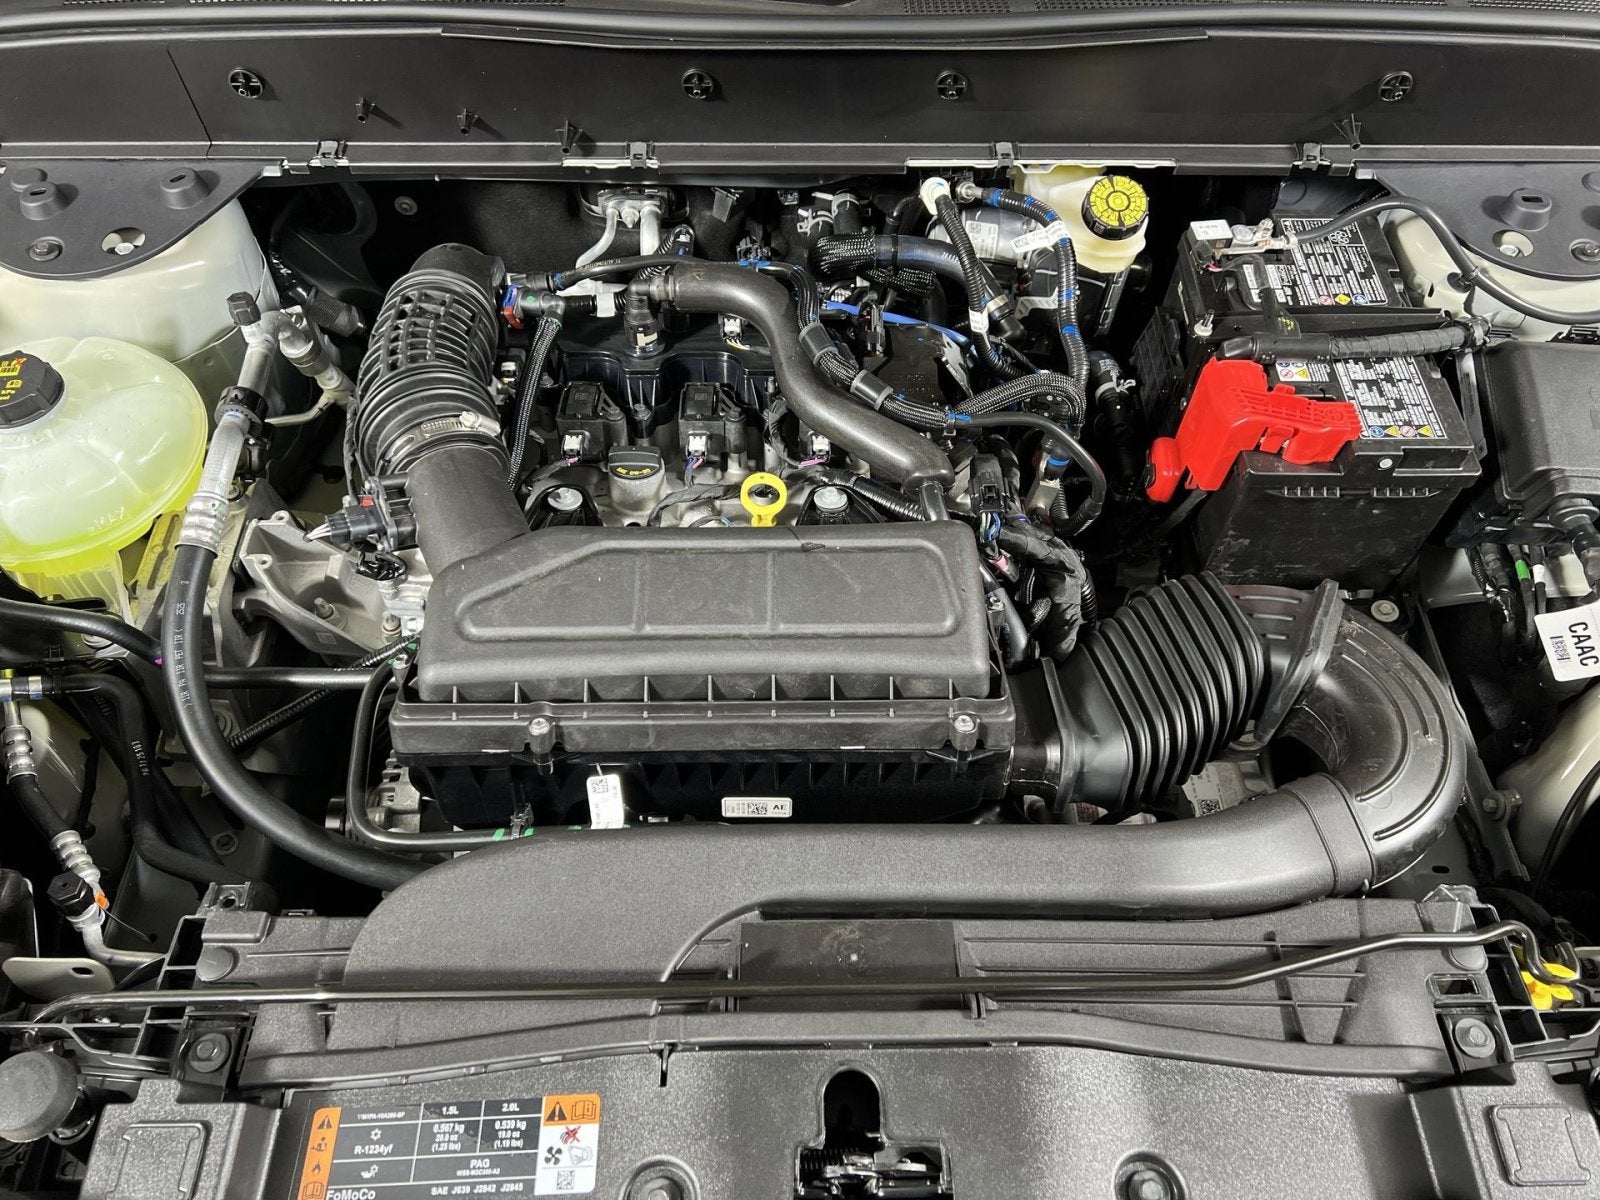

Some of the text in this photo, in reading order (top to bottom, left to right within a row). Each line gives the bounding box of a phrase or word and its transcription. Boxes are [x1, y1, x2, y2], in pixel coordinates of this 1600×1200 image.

[1568, 621, 1599, 667] CAAC
[174, 649, 184, 660] PET
[442, 1105, 459, 1115] 1.5L
[501, 1102, 520, 1112] 2.0L
[455, 1122, 465, 1134] kg
[516, 1119, 527, 1131] kg
[354, 1143, 394, 1156] R-1234yf
[469, 1158, 490, 1169] PAG
[326, 1188, 376, 1200] FoMoCo
[430, 1182, 524, 1196] SAE J639 J2842 J2845
